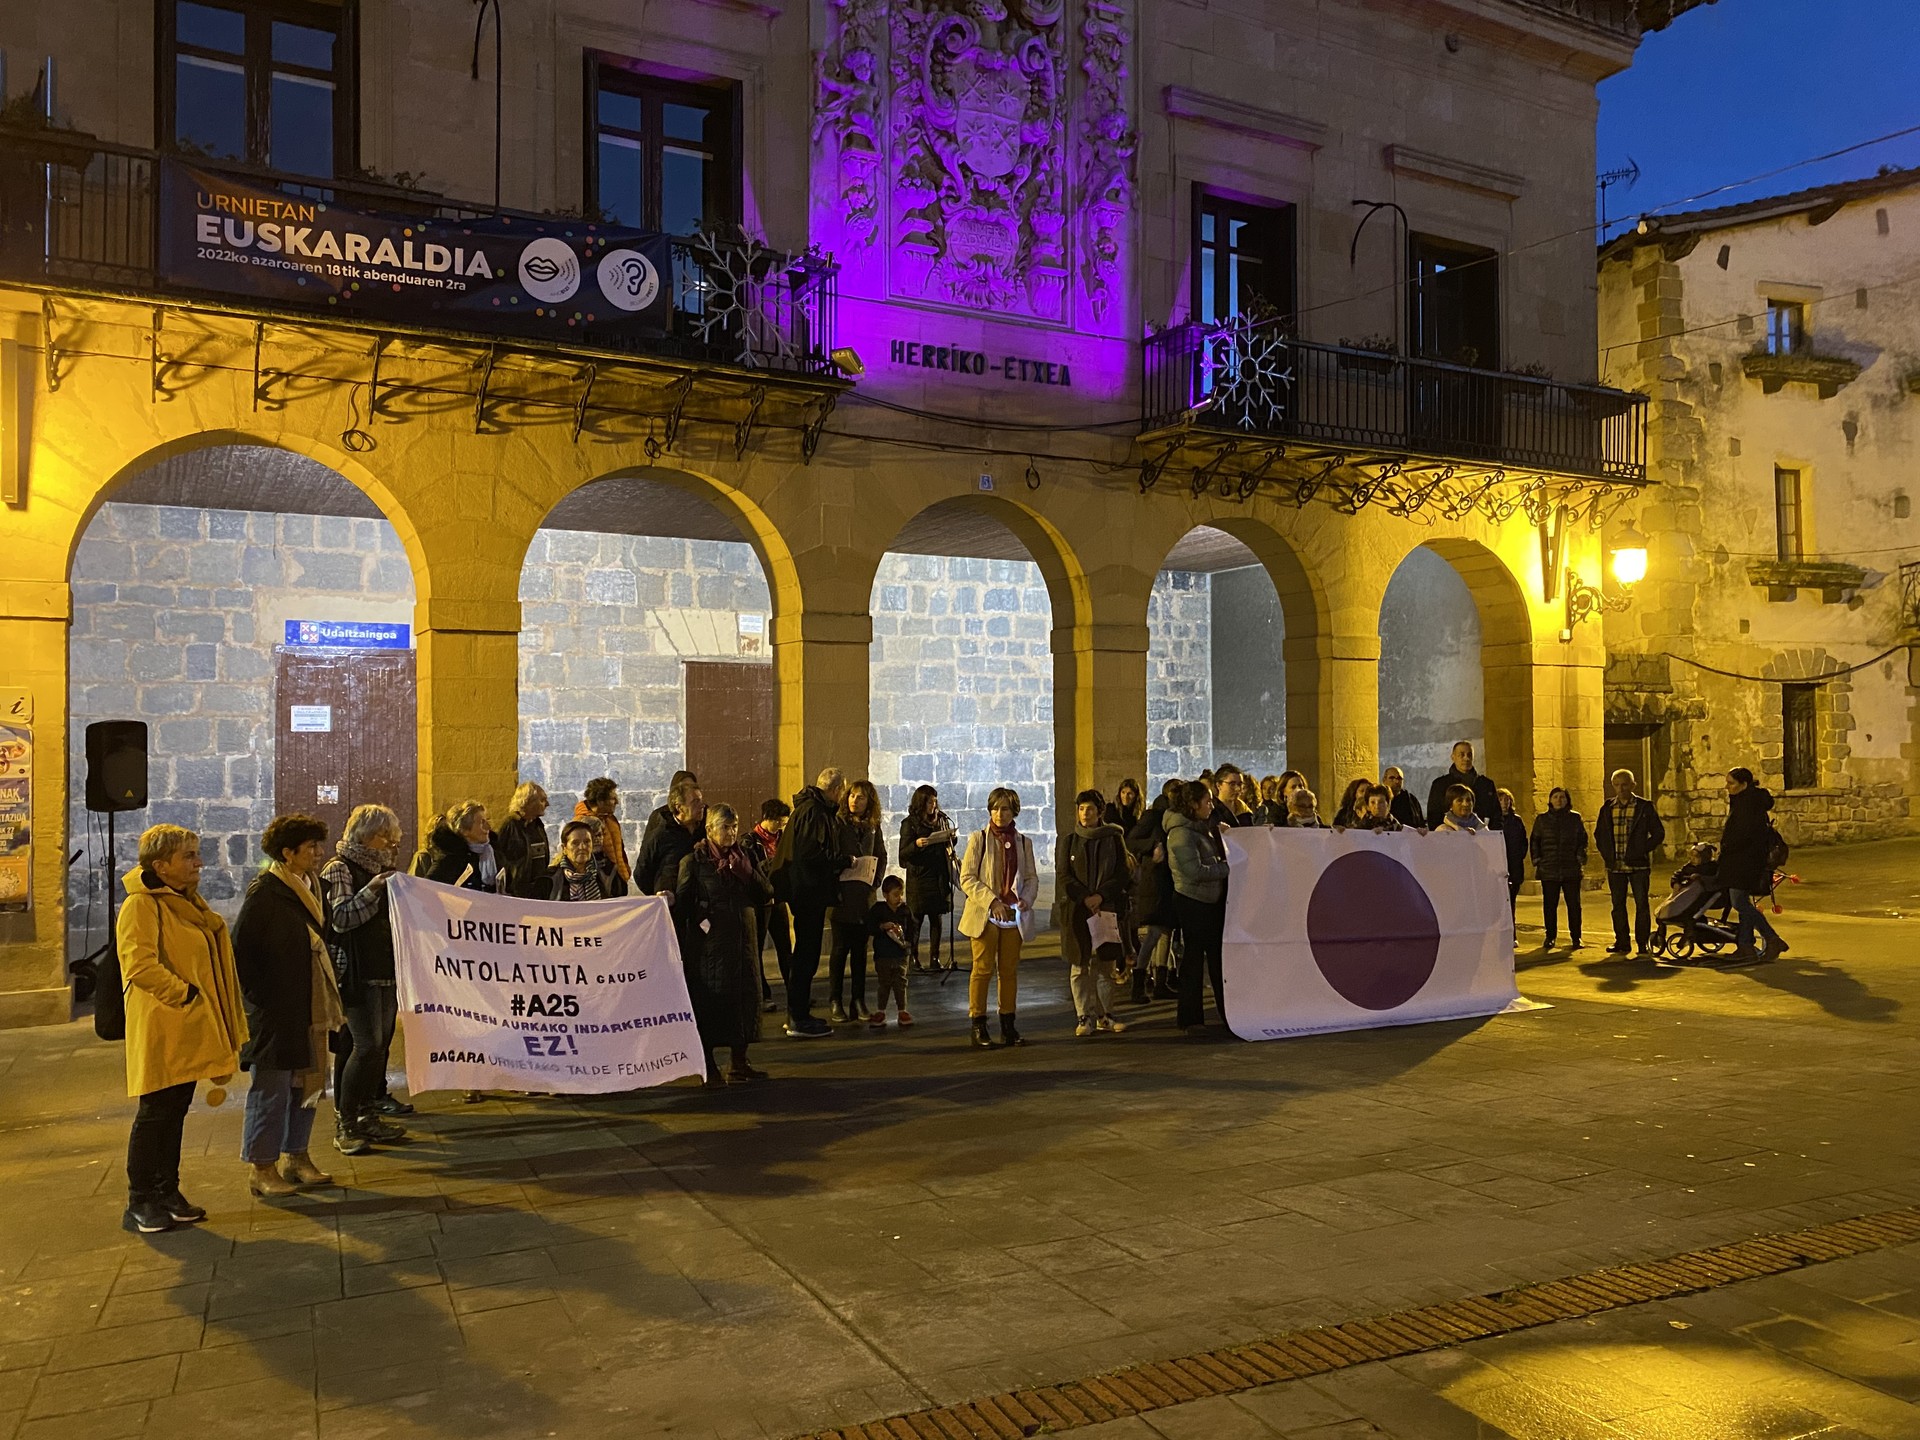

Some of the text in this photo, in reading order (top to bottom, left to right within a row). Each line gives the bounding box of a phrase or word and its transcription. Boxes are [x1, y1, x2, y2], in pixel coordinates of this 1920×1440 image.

[197, 192, 314, 222] URNIETAN
[197, 214, 493, 279] EUSKARALDIA
[197, 247, 466, 291] 2022ko azaroaren 18tik abenduaren 2ra
[322, 626, 397, 641] Udaltzaingoa
[447, 919, 603, 948] URNIETAN ERE
[435, 955, 647, 985] ANTOLATUTA GAUDE
[414, 1003, 693, 1034] EMAKUMEEN AURKAKO INDARKERIARIK
[511, 993, 580, 1018] #A25
[523, 1034, 579, 1057] EZ!
[430, 1050, 486, 1064] BAGARA
[566, 1064, 611, 1076] TALDE
[617, 1051, 688, 1076] FEMINISTA
